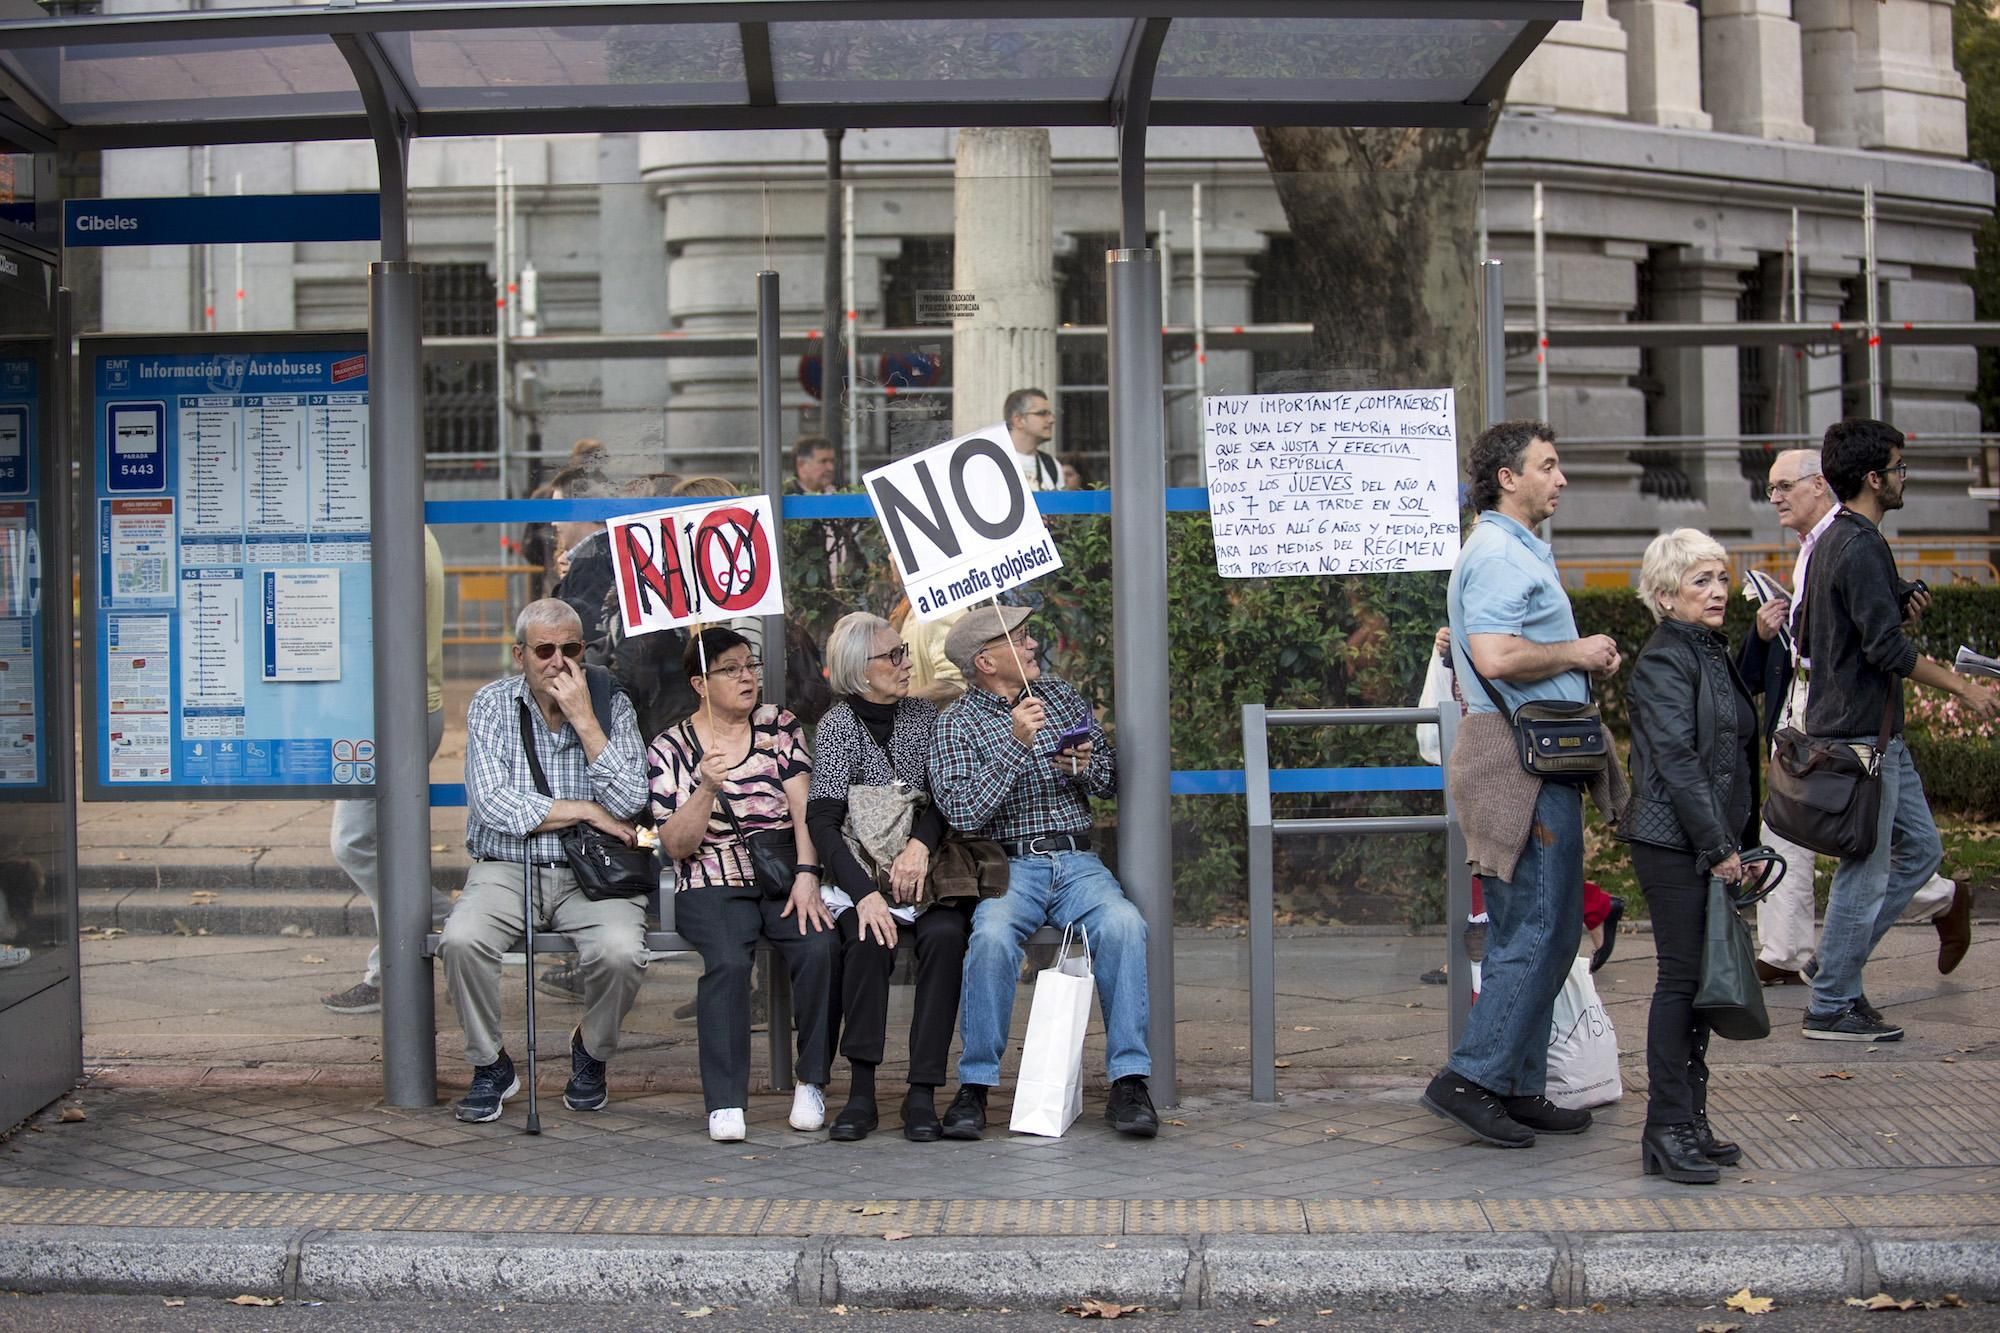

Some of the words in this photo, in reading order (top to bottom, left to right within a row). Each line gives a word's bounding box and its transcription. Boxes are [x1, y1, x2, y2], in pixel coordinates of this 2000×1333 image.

[76, 215, 138, 231] Cibeles
[955, 303, 979, 311] AUTORIZADA
[106, 360, 129, 369] EMT
[140, 361, 222, 378] Información
[227, 360, 243, 376] de
[248, 359, 322, 376] Autobuses
[184, 398, 195, 407] 14
[248, 398, 260, 406] 27
[312, 396, 323, 405] 37
[1245, 422, 1270, 435] UNA
[1277, 421, 1303, 433] LEY
[1310, 422, 1326, 434] DE
[1334, 420, 1391, 435] MEMORIA
[1400, 421, 1452, 437] HISTÓRICA
[1215, 443, 1242, 456] QUE
[1250, 441, 1275, 453] SEA
[1281, 438, 1319, 453] JUSTA
[1328, 441, 1338, 454] Y
[121, 464, 154, 475] 5443
[1246, 457, 1263, 469] LA
[1270, 454, 1344, 471] REPÚBLICA
[1210, 477, 1247, 496] TODOS
[1259, 479, 1280, 491] LOS
[1288, 472, 1353, 493] JUEVES
[1362, 480, 1386, 492] DEL
[1394, 478, 1419, 491] AÑO
[1427, 480, 1436, 492] A
[871, 438, 1025, 575] NO
[1213, 502, 1235, 515] LAS
[1242, 495, 1259, 516] 7
[1269, 500, 1286, 513] DE
[1294, 500, 1309, 511] LA
[1317, 499, 1363, 510] TARDE
[1372, 499, 1390, 511] EN
[1214, 523, 1276, 537] LLEVAMOS
[1286, 519, 1315, 534] ALLÍ
[1318, 519, 1329, 534] 6
[1332, 521, 1361, 533] AÑOS
[1369, 523, 1379, 535] Y
[102, 535, 110, 554] EMT
[1216, 545, 1240, 558] PARA
[1249, 544, 1268, 555] LOS
[1277, 541, 1323, 554] MEDIOS
[1333, 539, 1353, 551] DEL
[1364, 536, 1446, 557] RÉGIMEN
[185, 570, 197, 578] 45
[1219, 564, 1242, 575] ESTA
[1251, 560, 1309, 575] PROTESTA
[1319, 556, 1340, 572] NO
[1348, 557, 1408, 572] EXISTE
[918, 595, 931, 614] a
[929, 587, 948, 609] la
[948, 569, 992, 602] mafia
[991, 539, 1054, 590] golpista!
[266, 578, 274, 606] informa
[266, 607, 274, 624] EMT
[220, 743, 233, 752] 5€
